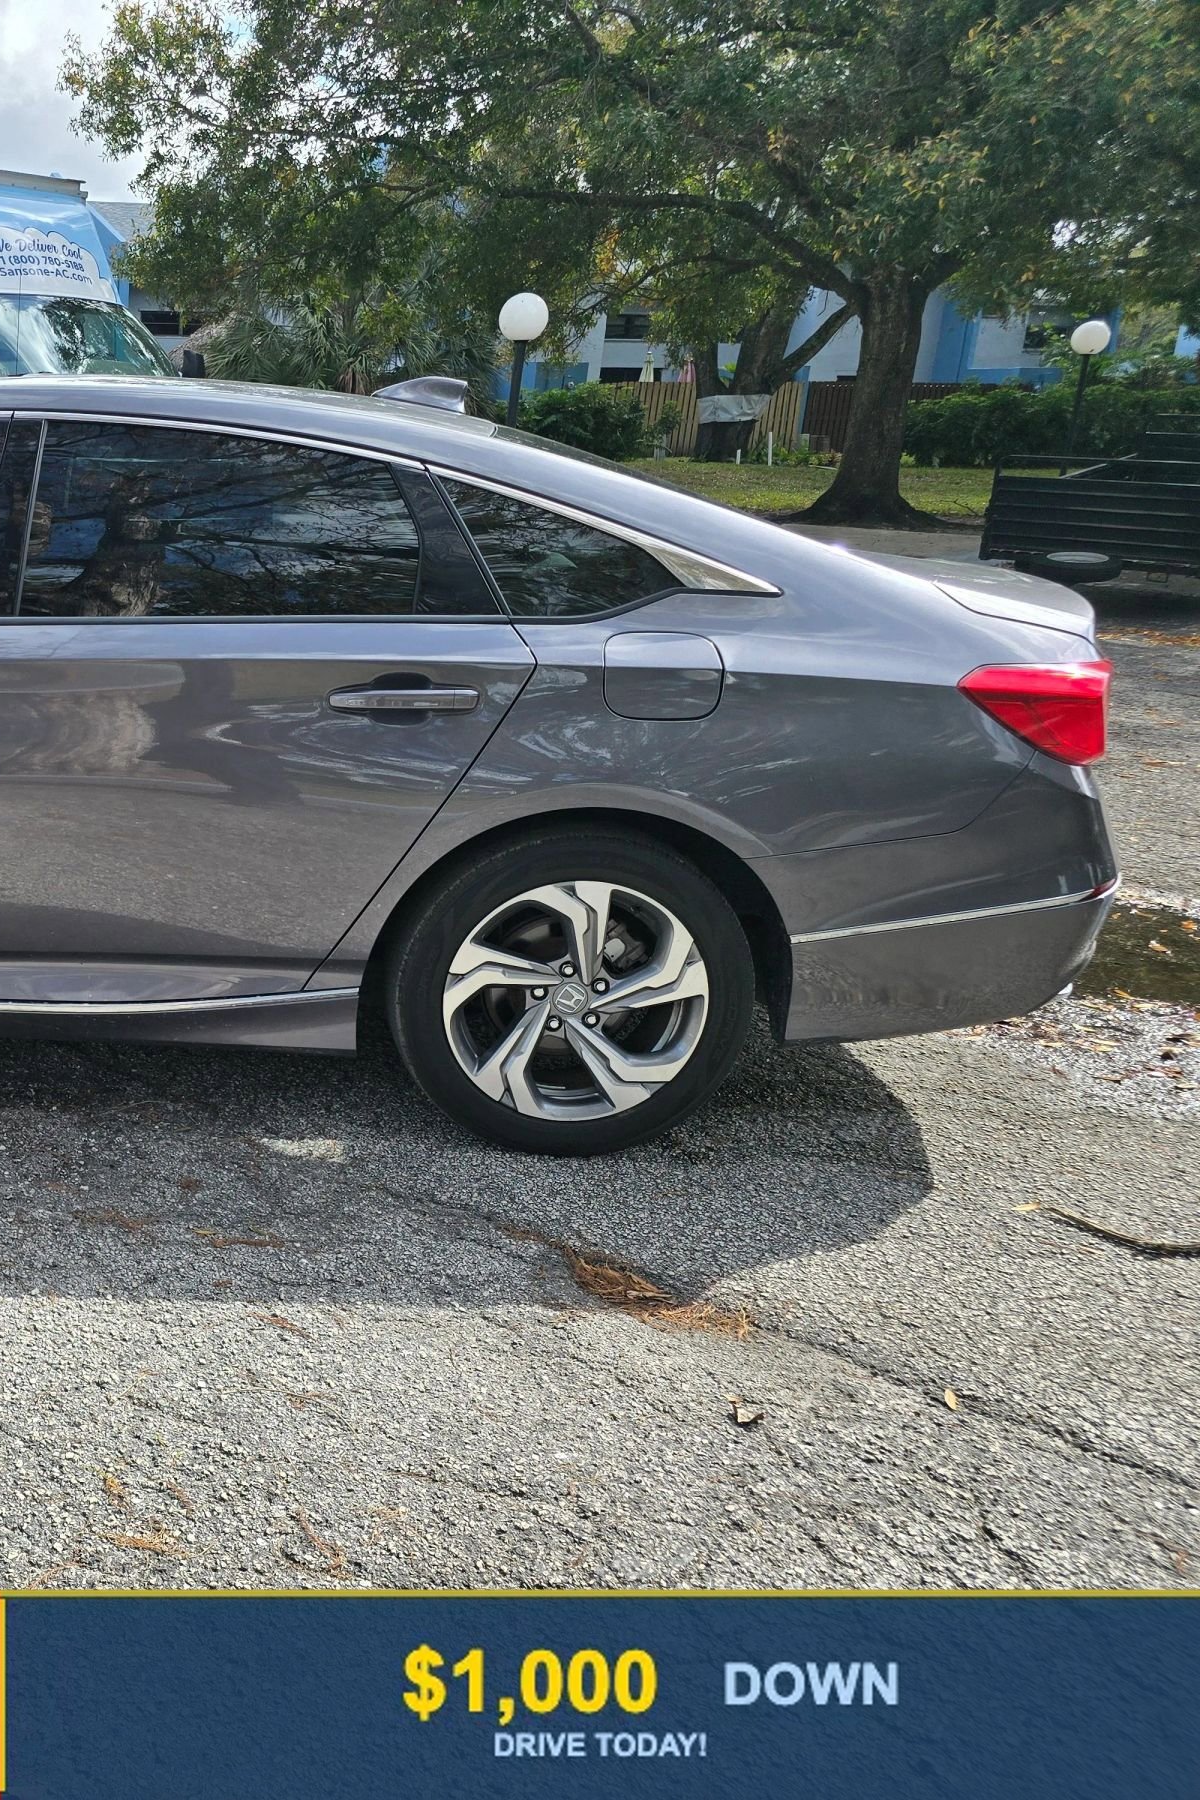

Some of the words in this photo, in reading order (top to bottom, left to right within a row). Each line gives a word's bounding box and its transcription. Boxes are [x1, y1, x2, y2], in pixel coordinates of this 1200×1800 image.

[15, 238, 59, 254] Deliver
[62, 244, 83, 261] Cool
[0, 256, 5, 265] 1
[8, 255, 40, 266] (800)
[44, 256, 85, 272] 780-5188
[0, 267, 93, 285] Sansone-AC.com
